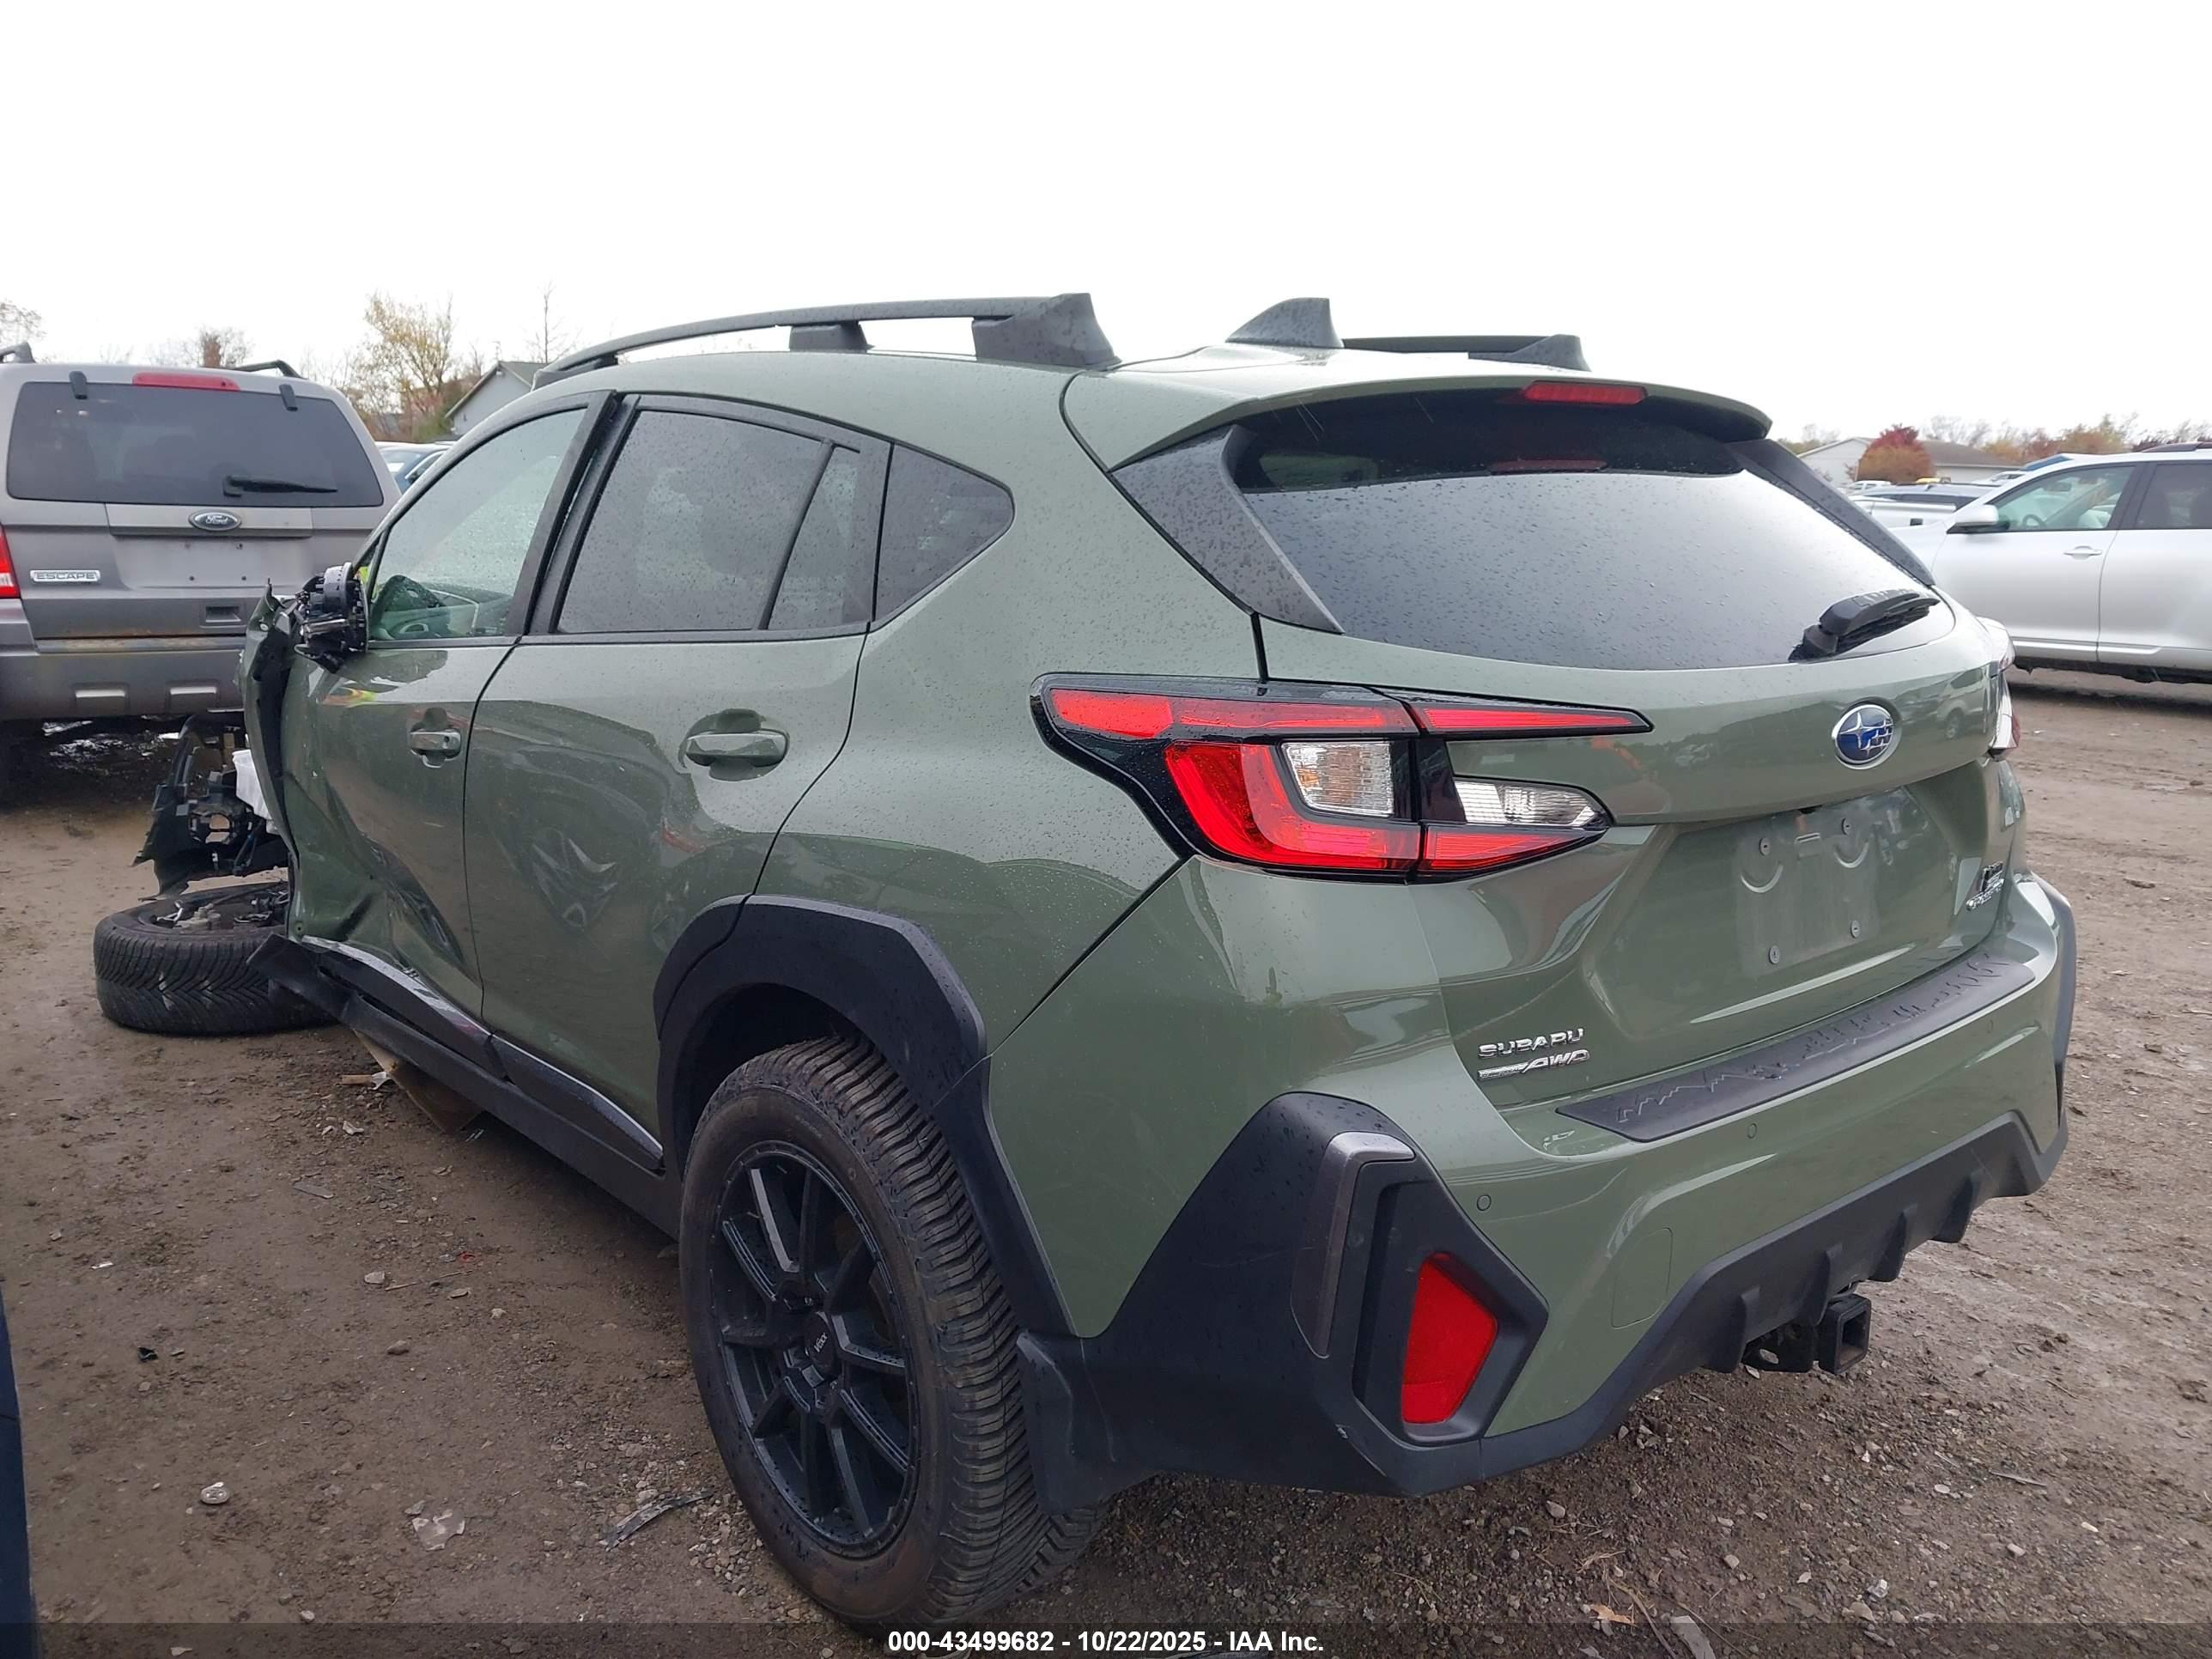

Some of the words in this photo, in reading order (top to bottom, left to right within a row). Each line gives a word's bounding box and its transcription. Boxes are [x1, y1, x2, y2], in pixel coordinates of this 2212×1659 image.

[35, 571, 97, 580] ESCAPE
[1478, 1028, 1584, 1058] SUBARU
[1522, 1048, 1590, 1073] AWD
